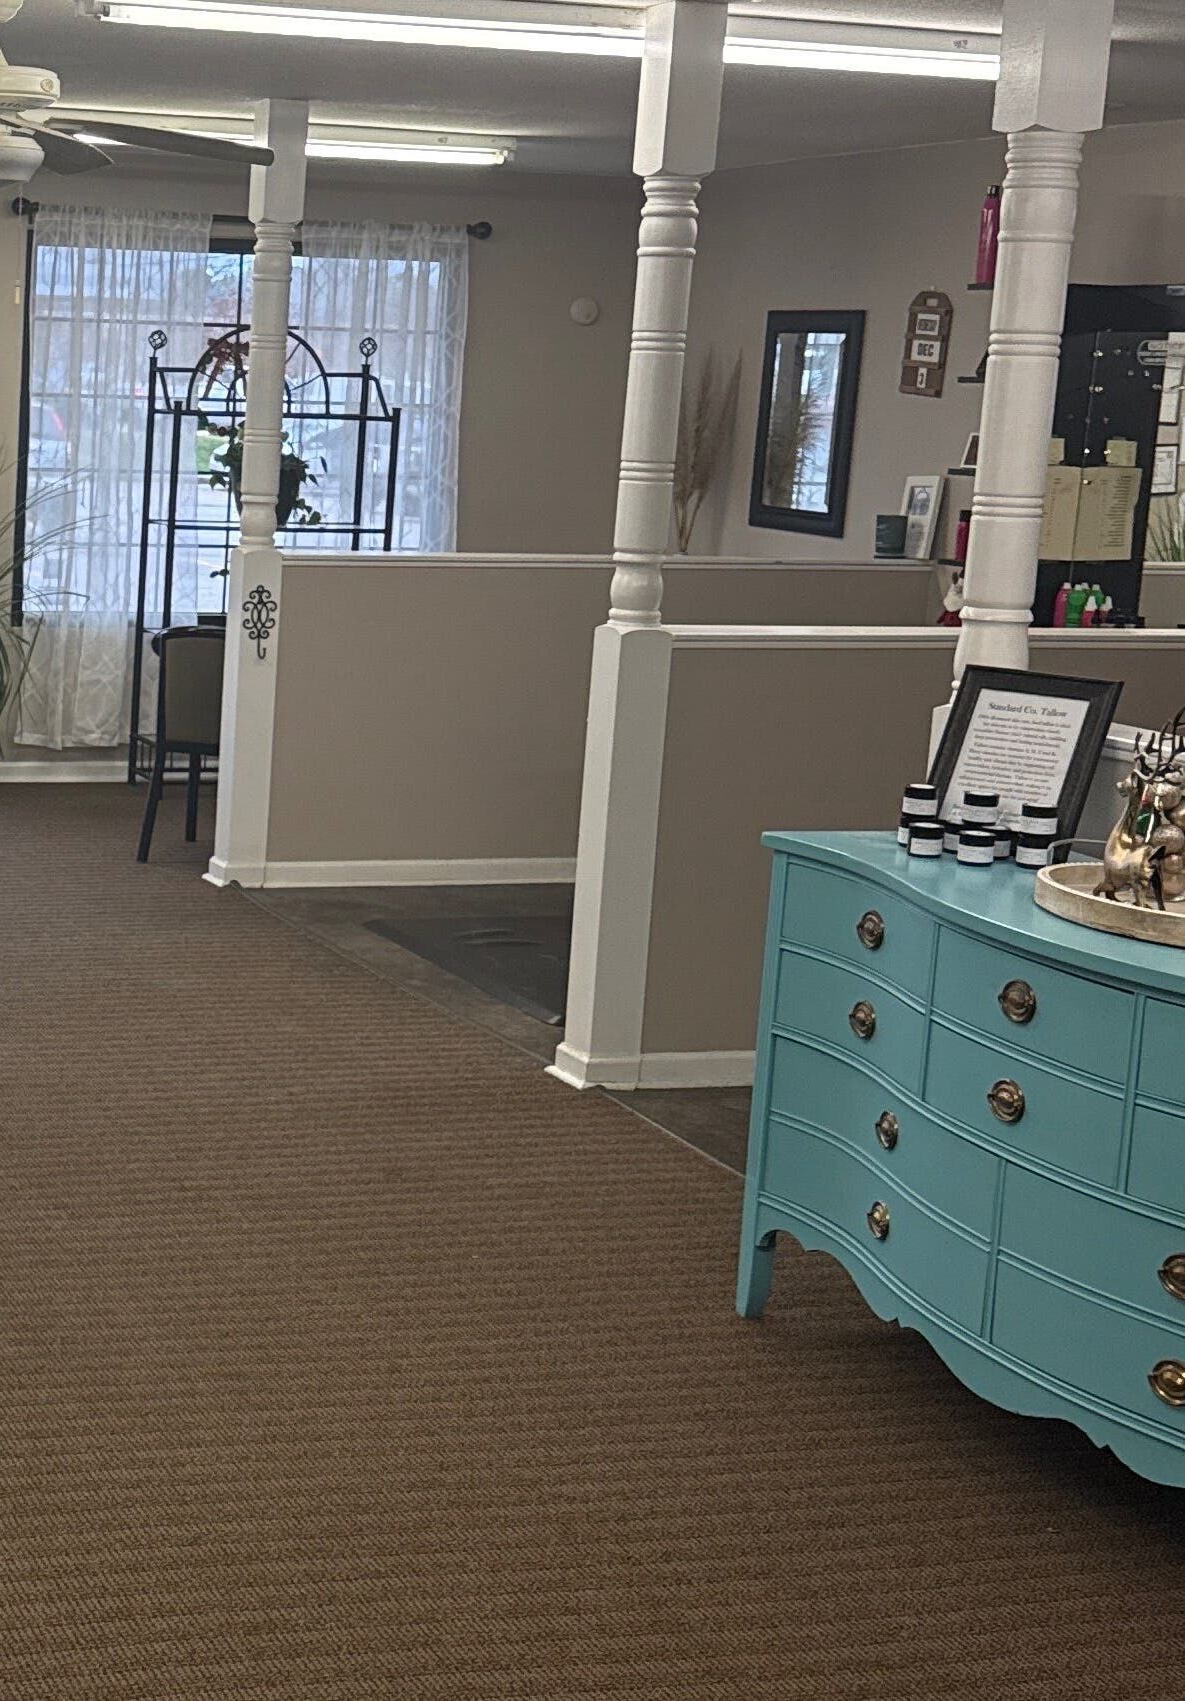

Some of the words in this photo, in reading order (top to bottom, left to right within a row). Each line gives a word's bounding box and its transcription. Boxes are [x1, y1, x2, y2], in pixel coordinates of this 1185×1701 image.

[917, 342, 935, 357] DEC
[989, 702, 1023, 714] Standard
[1023, 705, 1037, 715] Co.
[1041, 707, 1067, 718] Tallow
